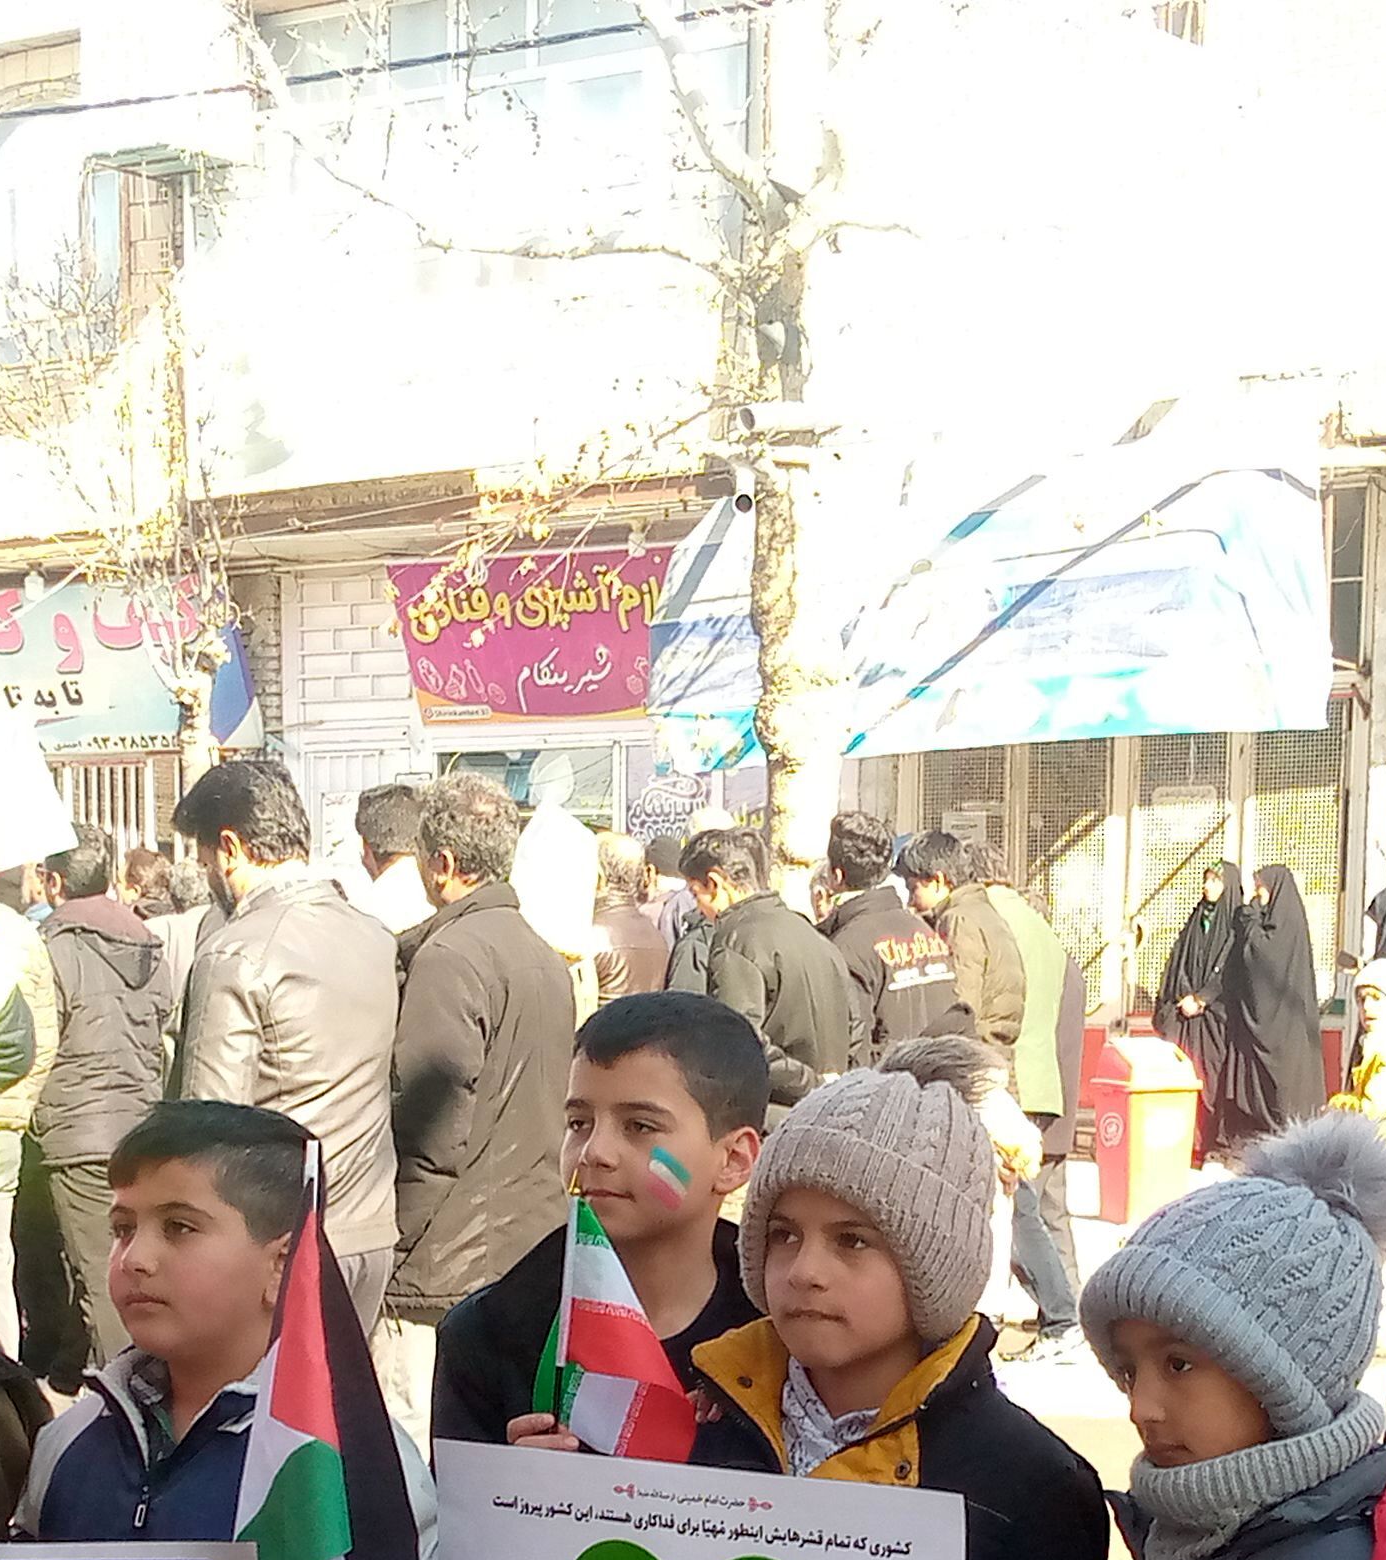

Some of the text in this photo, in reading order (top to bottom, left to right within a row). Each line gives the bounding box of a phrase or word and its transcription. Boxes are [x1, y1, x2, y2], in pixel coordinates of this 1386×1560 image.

[493, 592, 512, 629] و
[52, 611, 85, 674] و
[34, 684, 61, 716] به
[66, 680, 85, 707] تا
[492, 1494, 518, 1510] است
[520, 1500, 544, 1518] پیروز
[544, 1503, 573, 1518] کشور
[575, 1505, 593, 1522] این
[634, 1512, 676, 1531] فداکاری
[677, 1514, 700, 1536] برای
[727, 1524, 763, 1543] اینطور
[825, 1533, 851, 1552] تمام
[853, 1537, 868, 1551] که
[869, 1541, 913, 1558] کشوری
